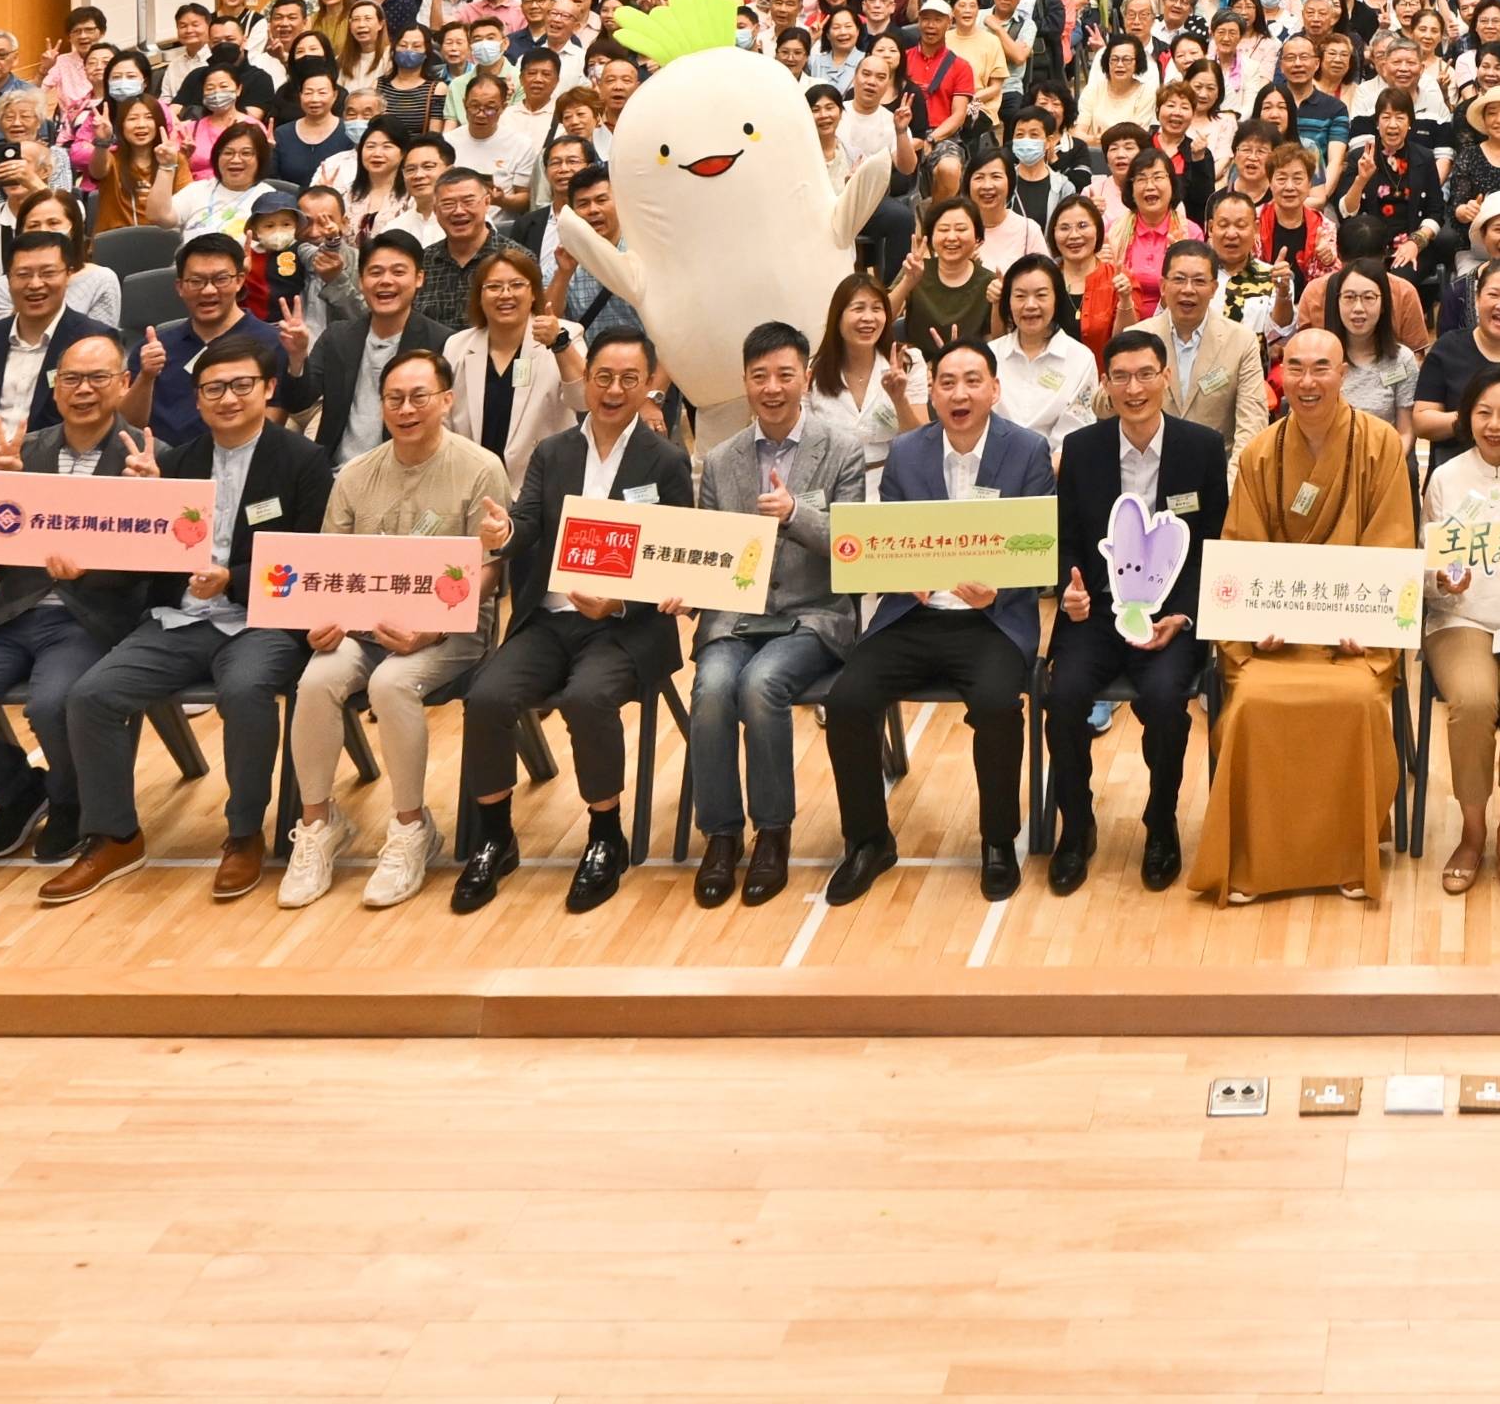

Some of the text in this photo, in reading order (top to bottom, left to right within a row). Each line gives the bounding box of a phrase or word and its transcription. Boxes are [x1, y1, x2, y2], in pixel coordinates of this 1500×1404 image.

[30, 513, 169, 534] 香港深圳社團總會
[566, 547, 597, 566] 香港
[642, 544, 734, 568] 香港重慶總會
[302, 572, 433, 595] 香港義工聯盟
[1250, 578, 1392, 604] 香港佛教聯合會
[1245, 599, 1394, 614] THE HONG KONG BUDDHIST ASSOCIATION
